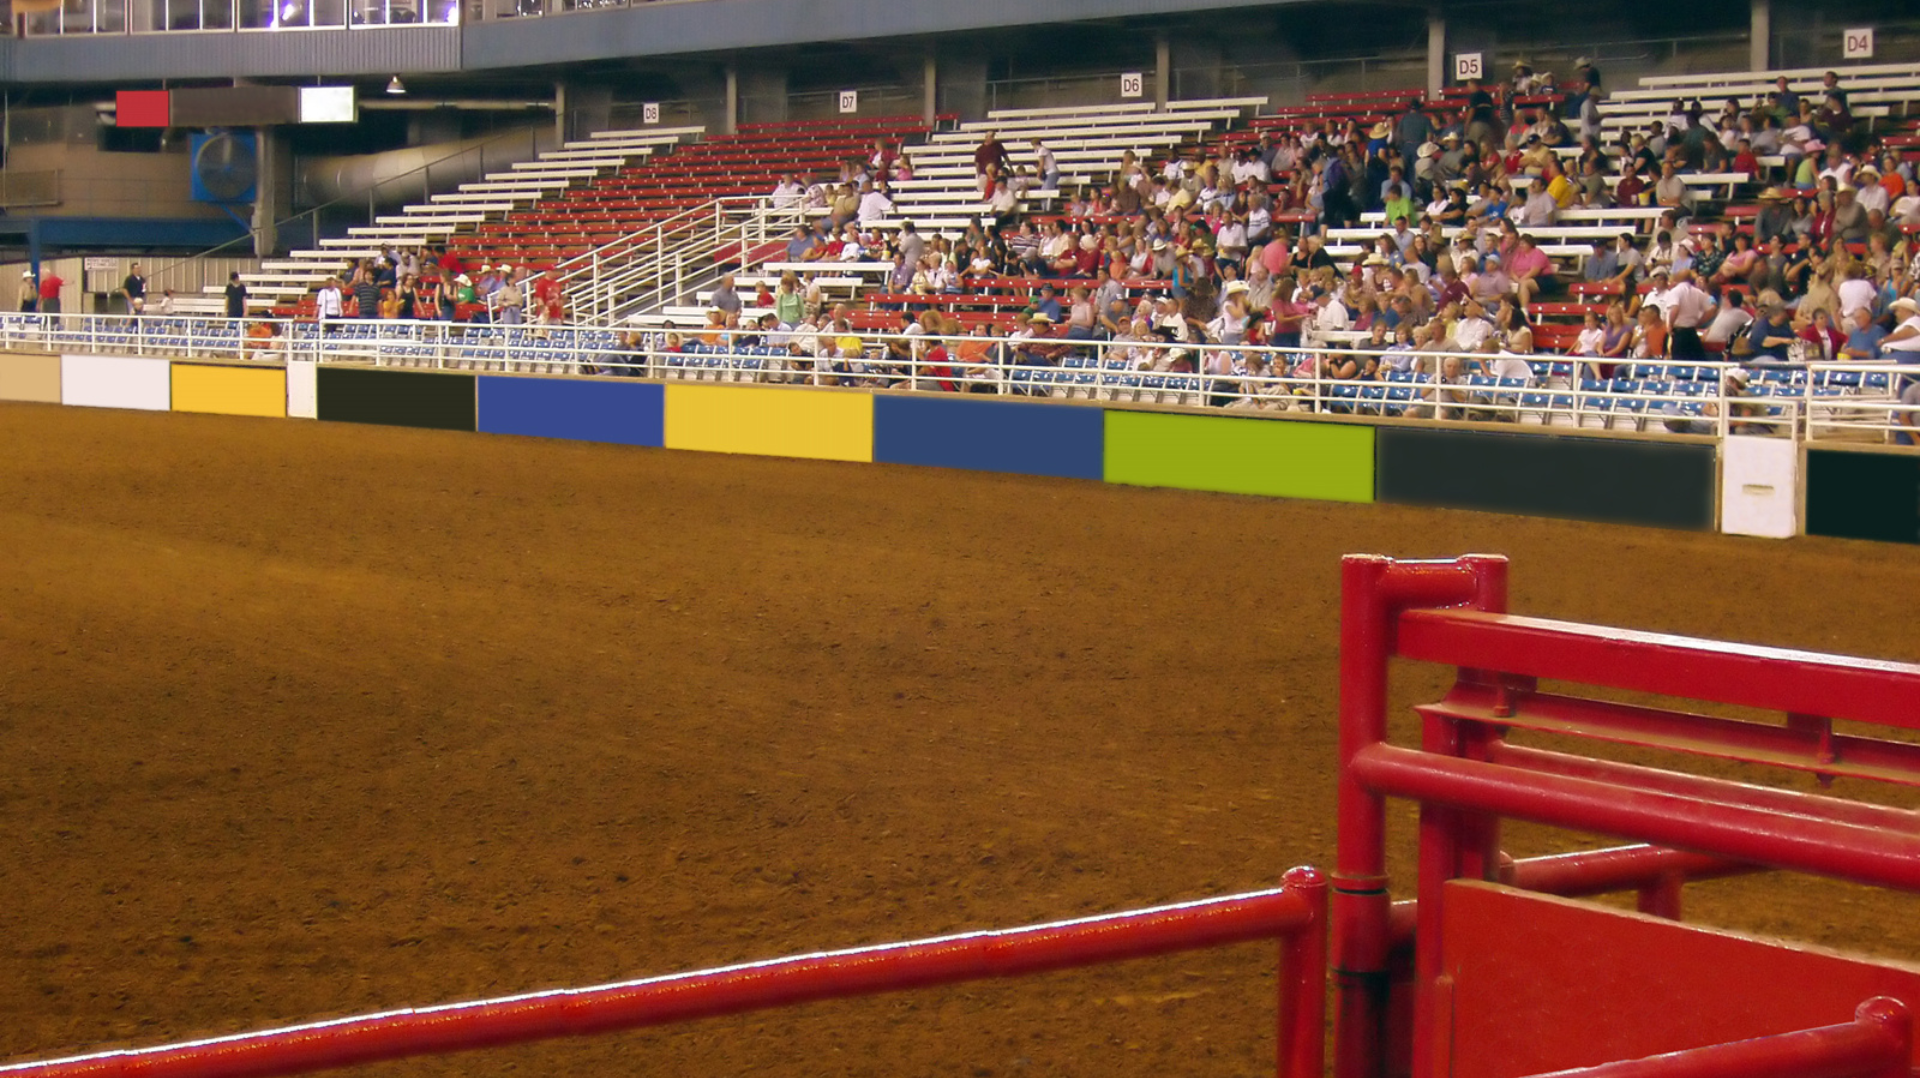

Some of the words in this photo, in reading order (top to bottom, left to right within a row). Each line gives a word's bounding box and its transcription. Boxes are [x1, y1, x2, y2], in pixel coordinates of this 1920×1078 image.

[1847, 34, 1868, 52] D4
[1459, 59, 1478, 74] D5
[1123, 78, 1140, 92] D6
[842, 95, 854, 109] D7
[645, 107, 657, 120] D8
